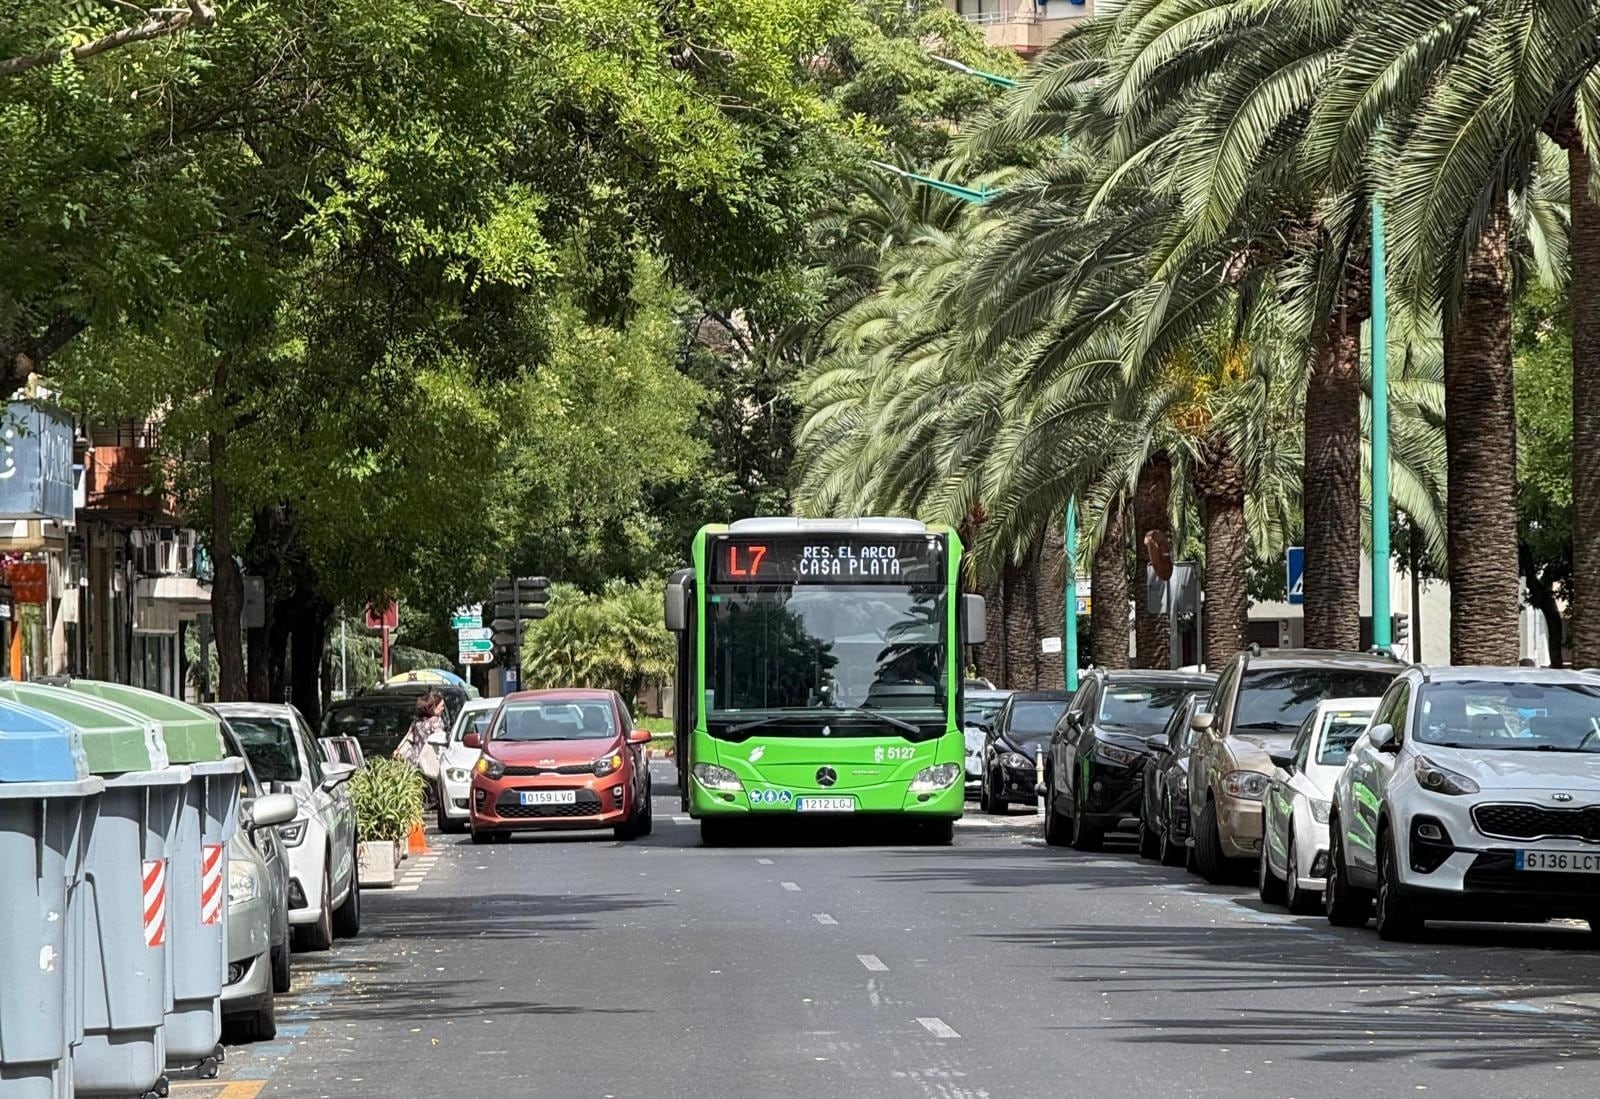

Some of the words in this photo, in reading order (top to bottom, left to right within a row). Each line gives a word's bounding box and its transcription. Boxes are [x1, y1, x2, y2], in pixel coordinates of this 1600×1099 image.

[803, 546, 834, 558] RES.
[838, 546, 856, 558] EL
[861, 546, 896, 558] ARCO
[730, 546, 767, 575] L7
[800, 559, 841, 575] CASA
[849, 559, 900, 575] PLATA
[887, 747, 916, 759] 5127
[527, 793, 552, 802] 0159
[554, 792, 573, 802] LVG
[805, 799, 830, 809] 1212
[833, 799, 852, 809] LGJ
[1527, 853, 1568, 869] 6136
[1572, 855, 1600, 870] LCT
